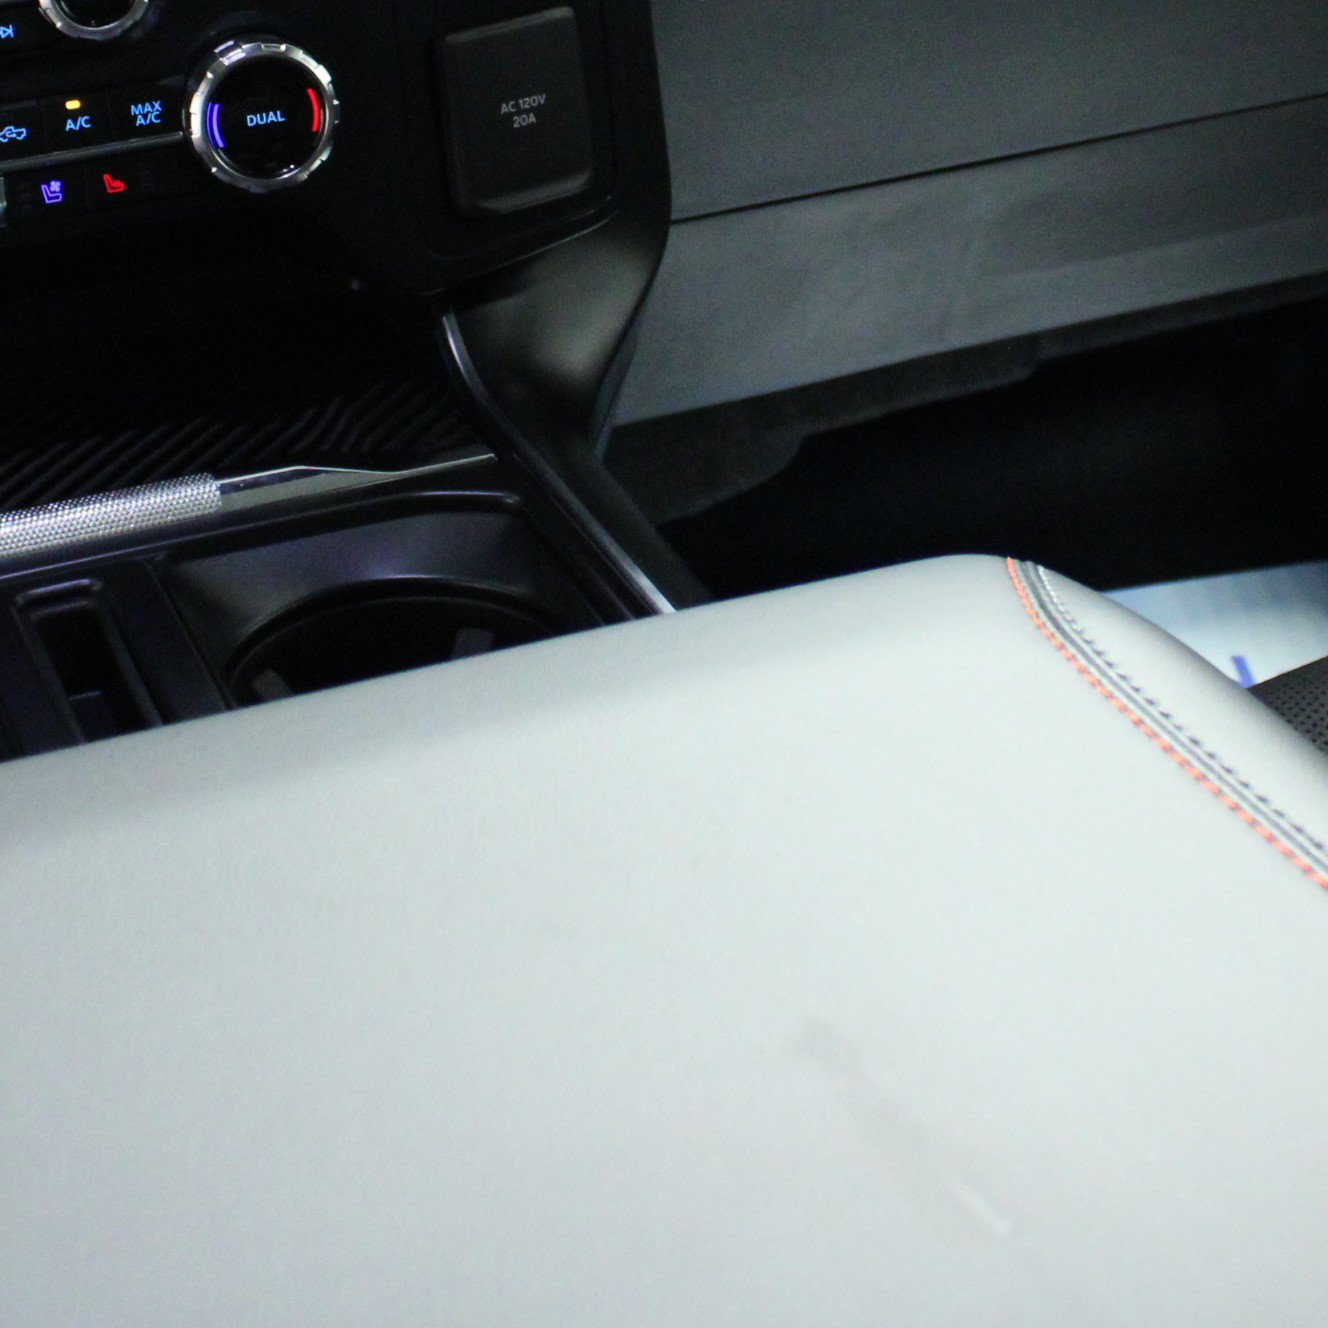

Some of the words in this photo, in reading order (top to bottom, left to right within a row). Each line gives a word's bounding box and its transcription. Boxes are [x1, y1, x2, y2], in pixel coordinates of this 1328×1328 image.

[130, 100, 163, 117] MAX
[500, 101, 517, 116] AC
[518, 93, 547, 111] 120V
[65, 115, 92, 132] A/C
[135, 111, 163, 127] A/C
[246, 110, 286, 127] DUAL
[512, 112, 537, 128] 20A
